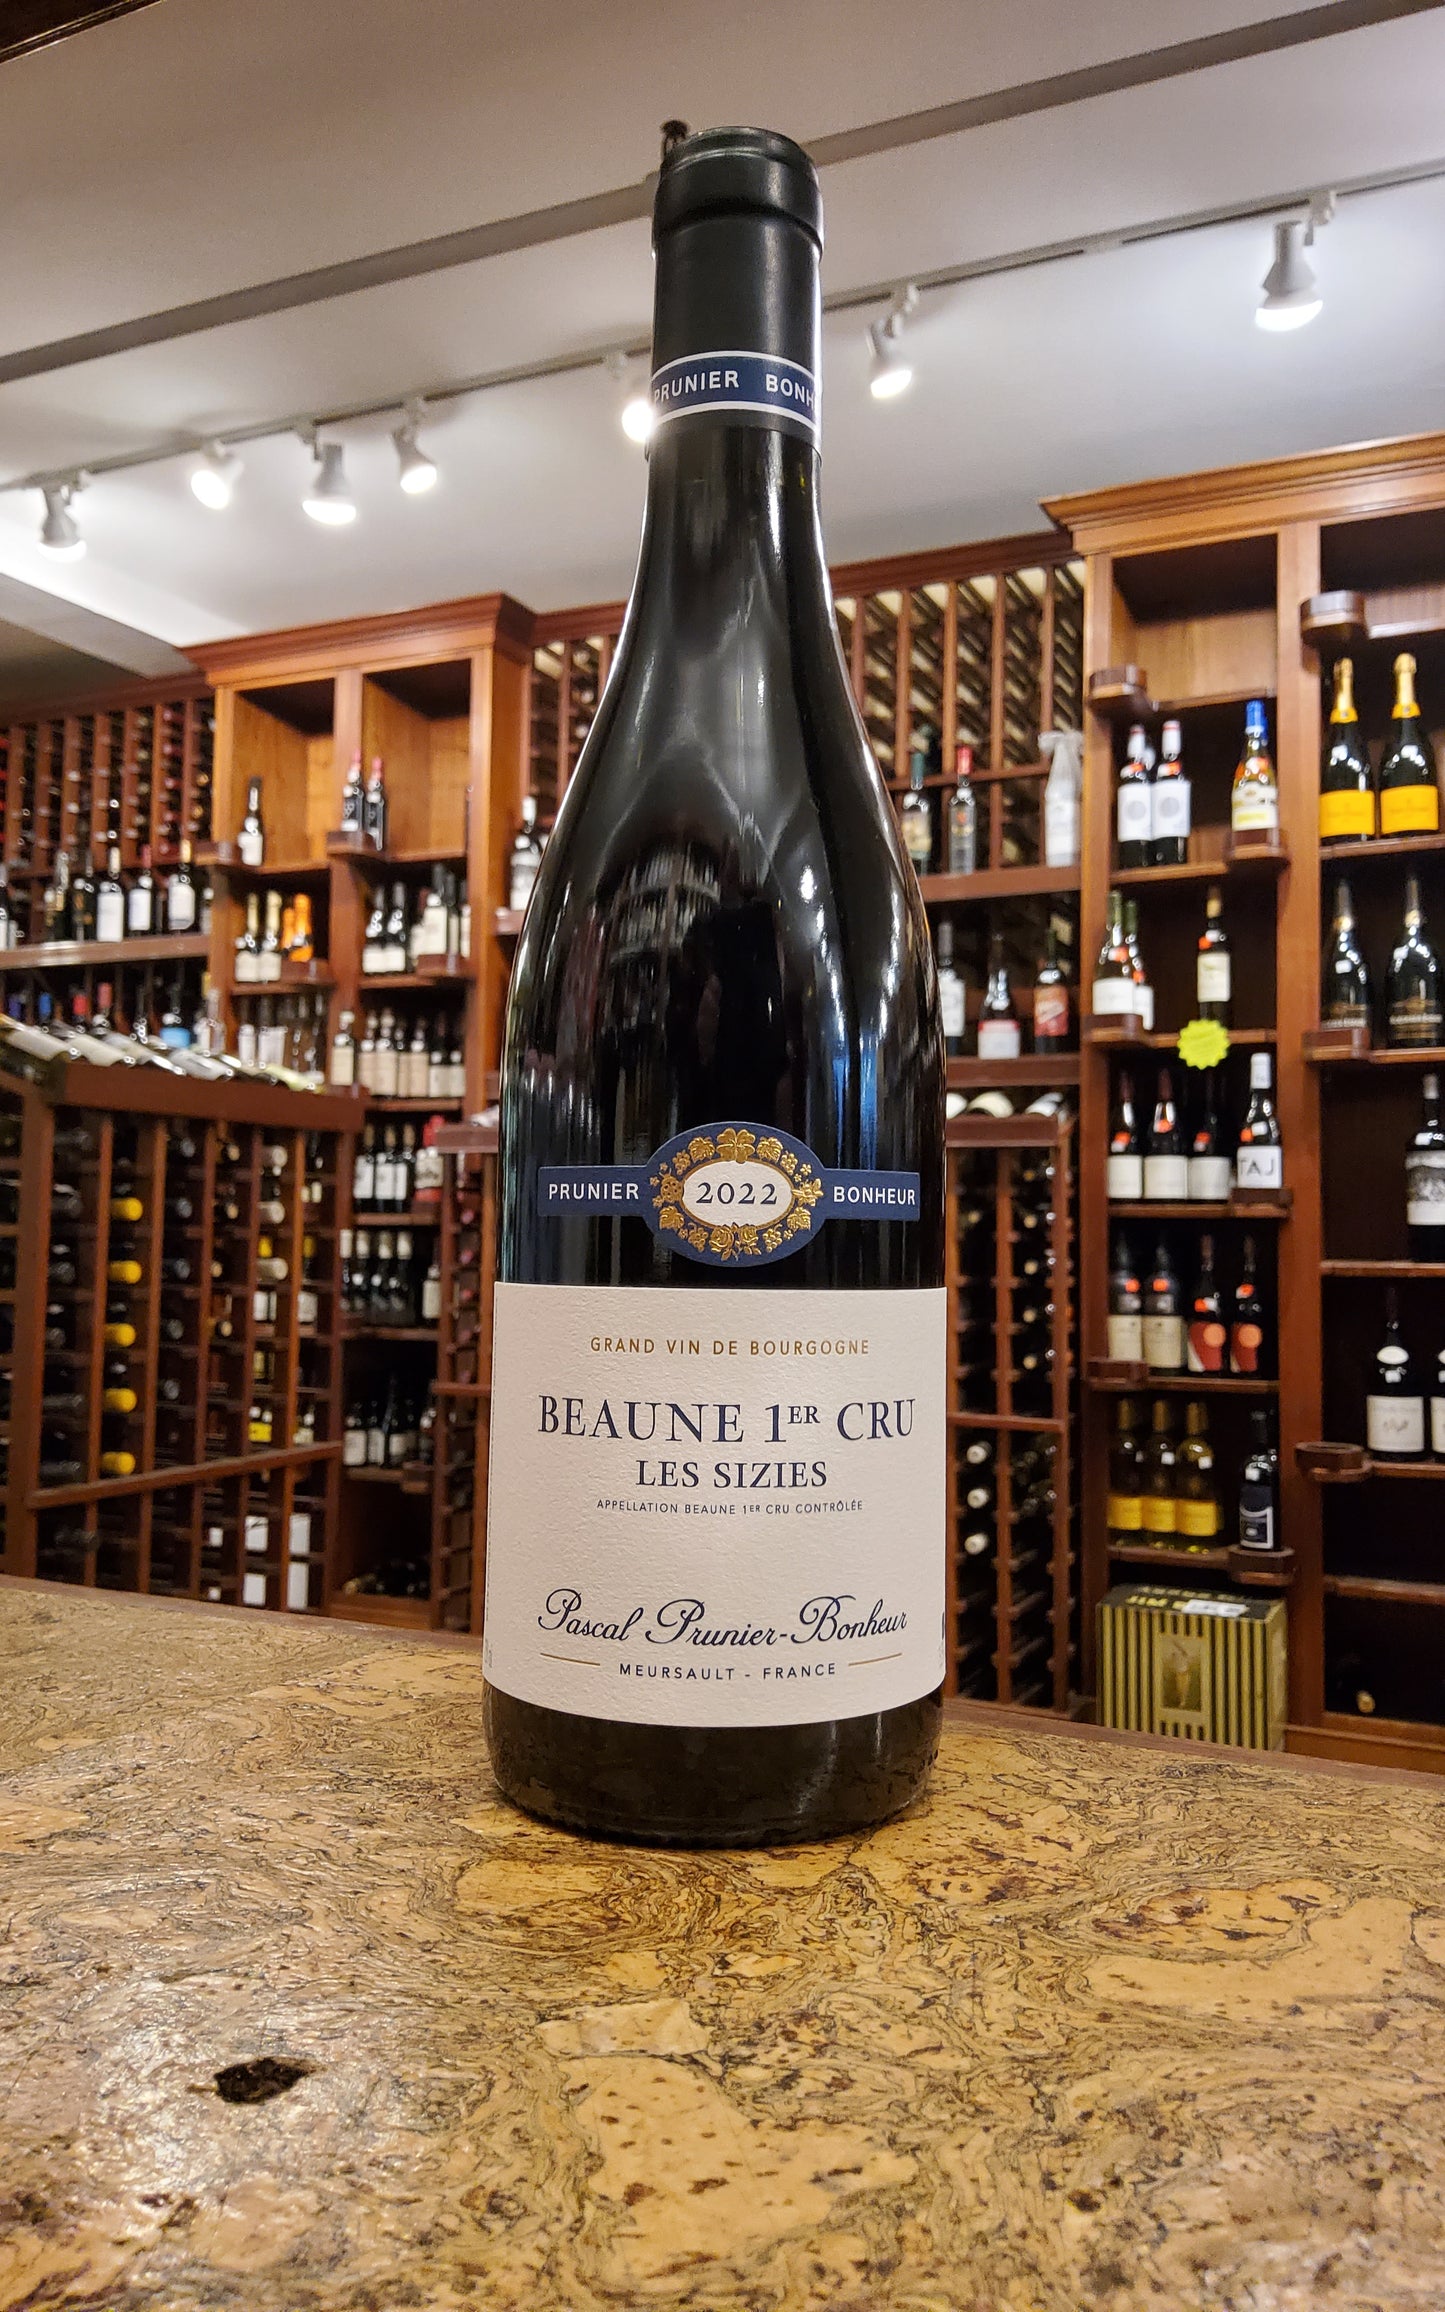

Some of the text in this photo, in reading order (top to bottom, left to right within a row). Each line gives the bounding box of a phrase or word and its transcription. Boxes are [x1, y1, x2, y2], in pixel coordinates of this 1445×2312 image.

[654, 370, 740, 402] PRUNIER
[548, 1181, 916, 1206] PRUNIER 2022 BONHEUR
[590, 1336, 869, 1356] GRAND VIN DE BOURGOGNE
[537, 1394, 916, 1443] BEAUNE 1ER CRU
[635, 1459, 827, 1489] LES SIZIES
[596, 1499, 678, 1514] APPELLATION
[684, 1503, 736, 1515] BEAUNE
[765, 1504, 790, 1515] CRU
[795, 1499, 863, 1514] CONTRÔLÉE
[537, 1588, 645, 1642] Pascal
[644, 1594, 908, 1647] Prunier-Bonheur
[619, 1662, 735, 1681] MEURSAULT
[763, 1662, 836, 1680] FRANCE
